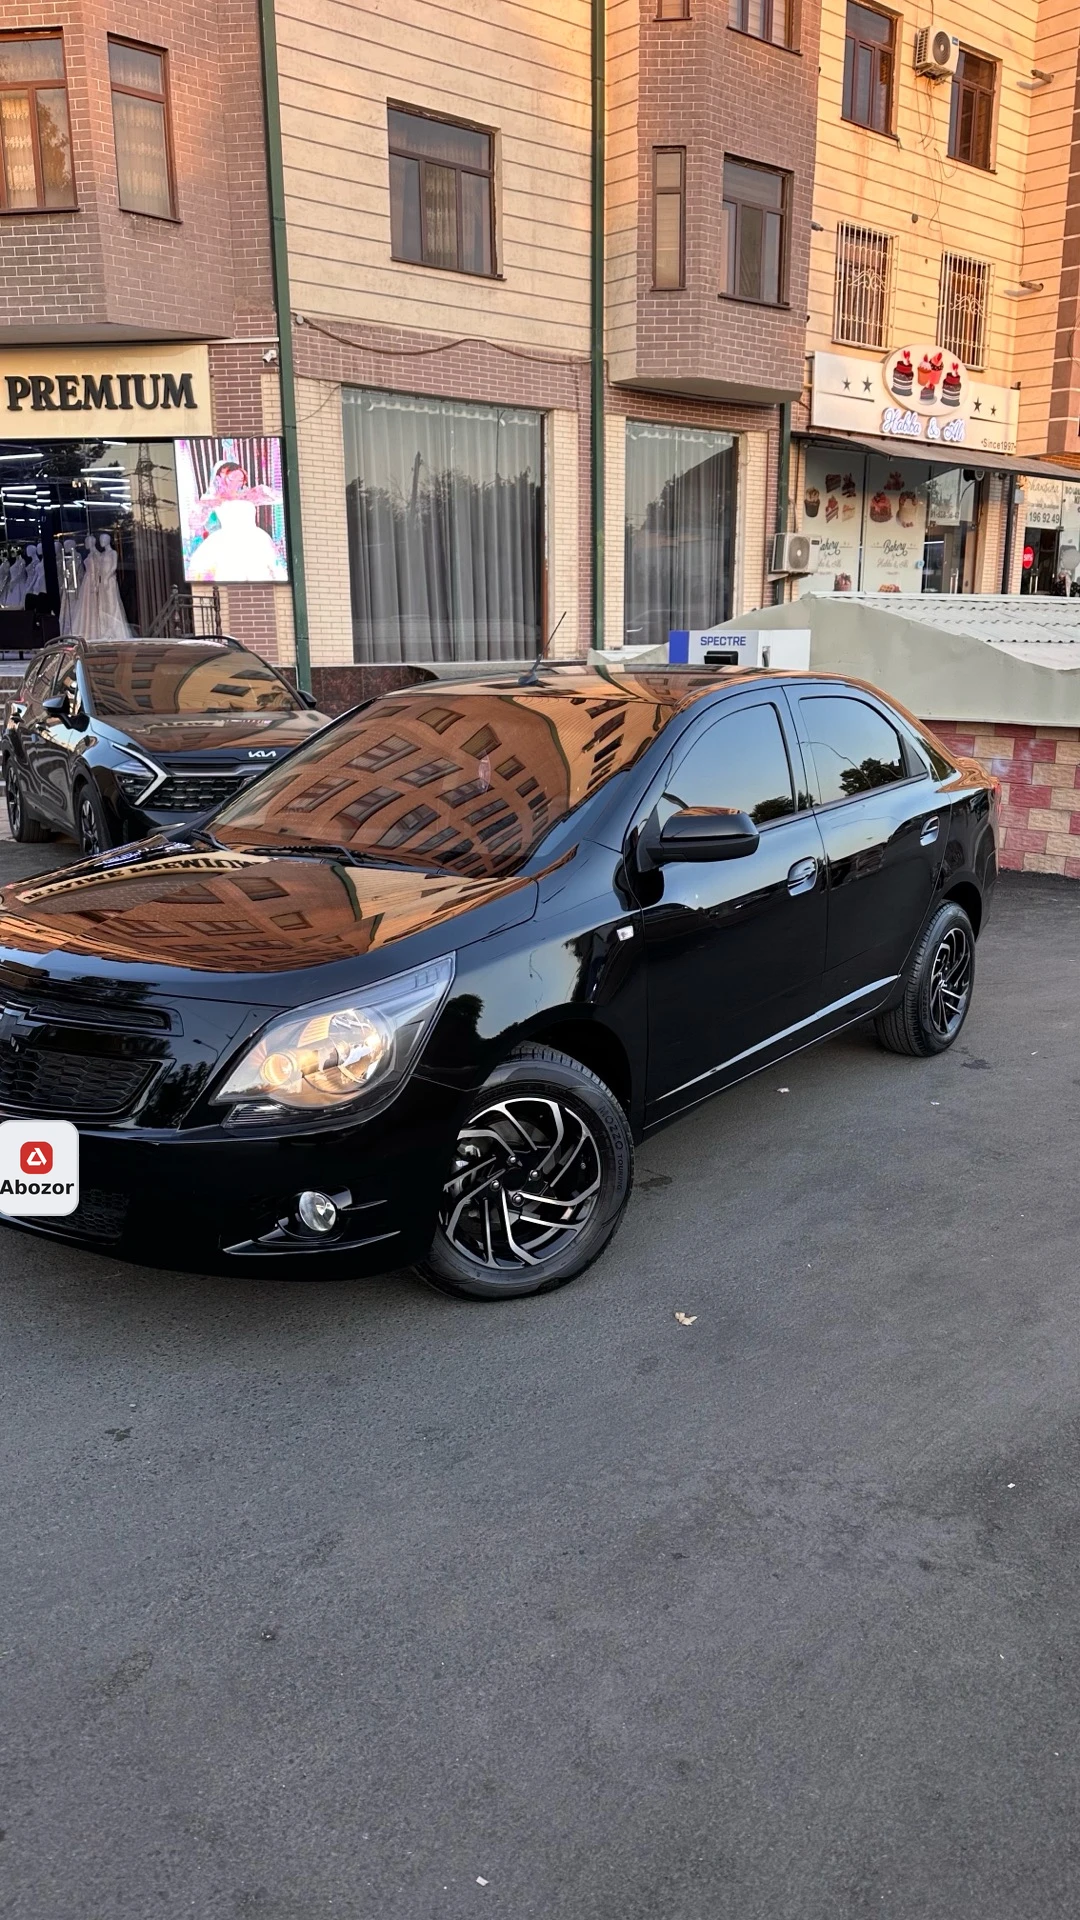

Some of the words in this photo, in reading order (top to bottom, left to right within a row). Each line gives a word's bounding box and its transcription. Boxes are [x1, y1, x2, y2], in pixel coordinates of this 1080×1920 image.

[5, 373, 197, 411] PREMIUM
[927, 417, 940, 438] &
[1042, 512, 1051, 523] 92
[1051, 513, 1060, 524] 49
[820, 537, 841, 556] akery
[883, 539, 908, 556] Bakery
[700, 636, 746, 647] SPECTRE
[248, 750, 277, 758] KIA
[598, 1106, 623, 1150] MOZZO
